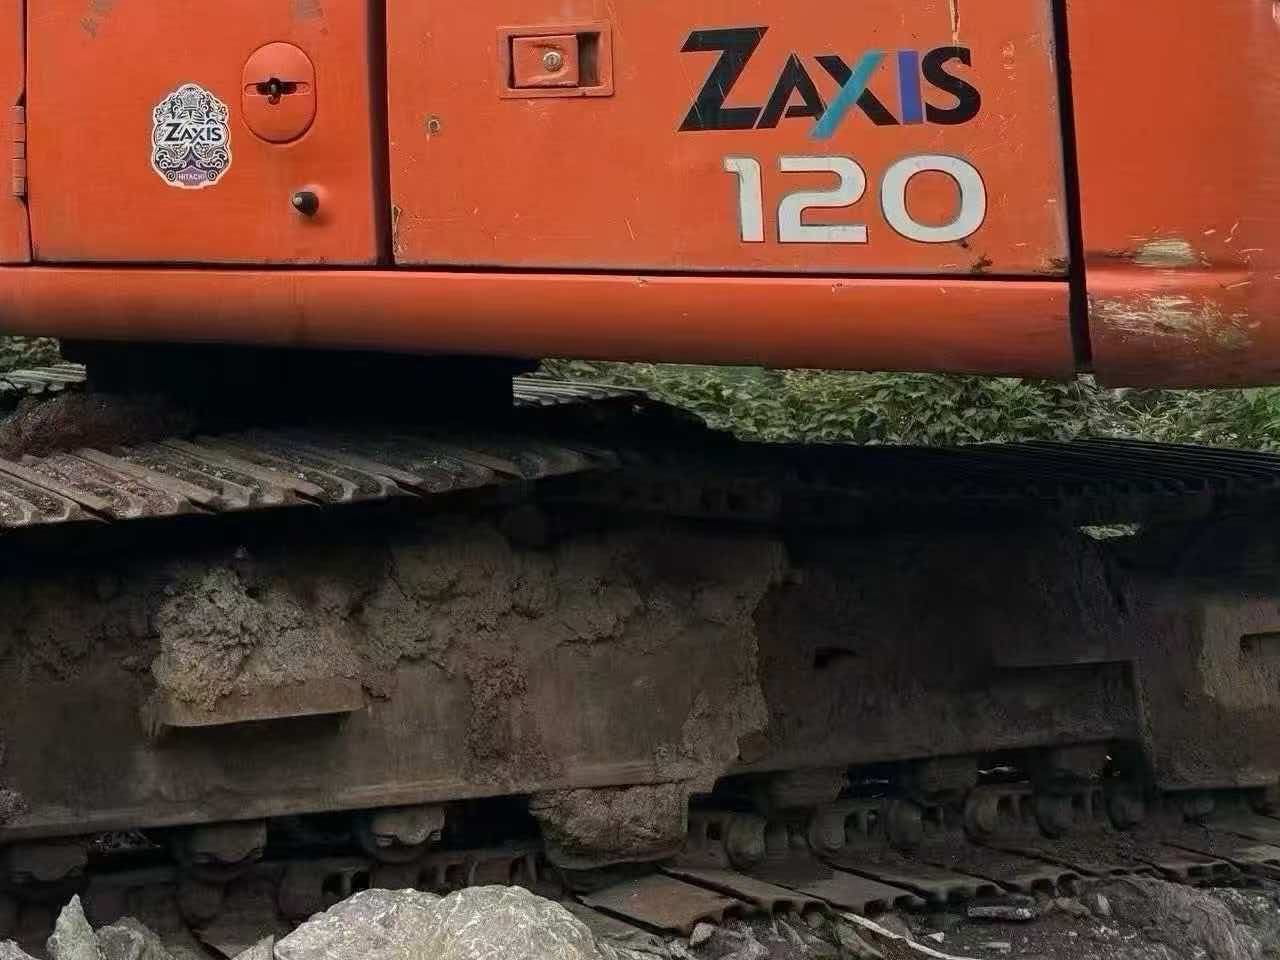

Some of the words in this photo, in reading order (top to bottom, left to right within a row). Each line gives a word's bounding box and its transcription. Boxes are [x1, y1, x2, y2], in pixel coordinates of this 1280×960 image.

[677, 26, 981, 141] ZAXIS
[164, 122, 222, 144] ZAXIS
[178, 172, 206, 181] HITACHI
[723, 156, 987, 243] 120
